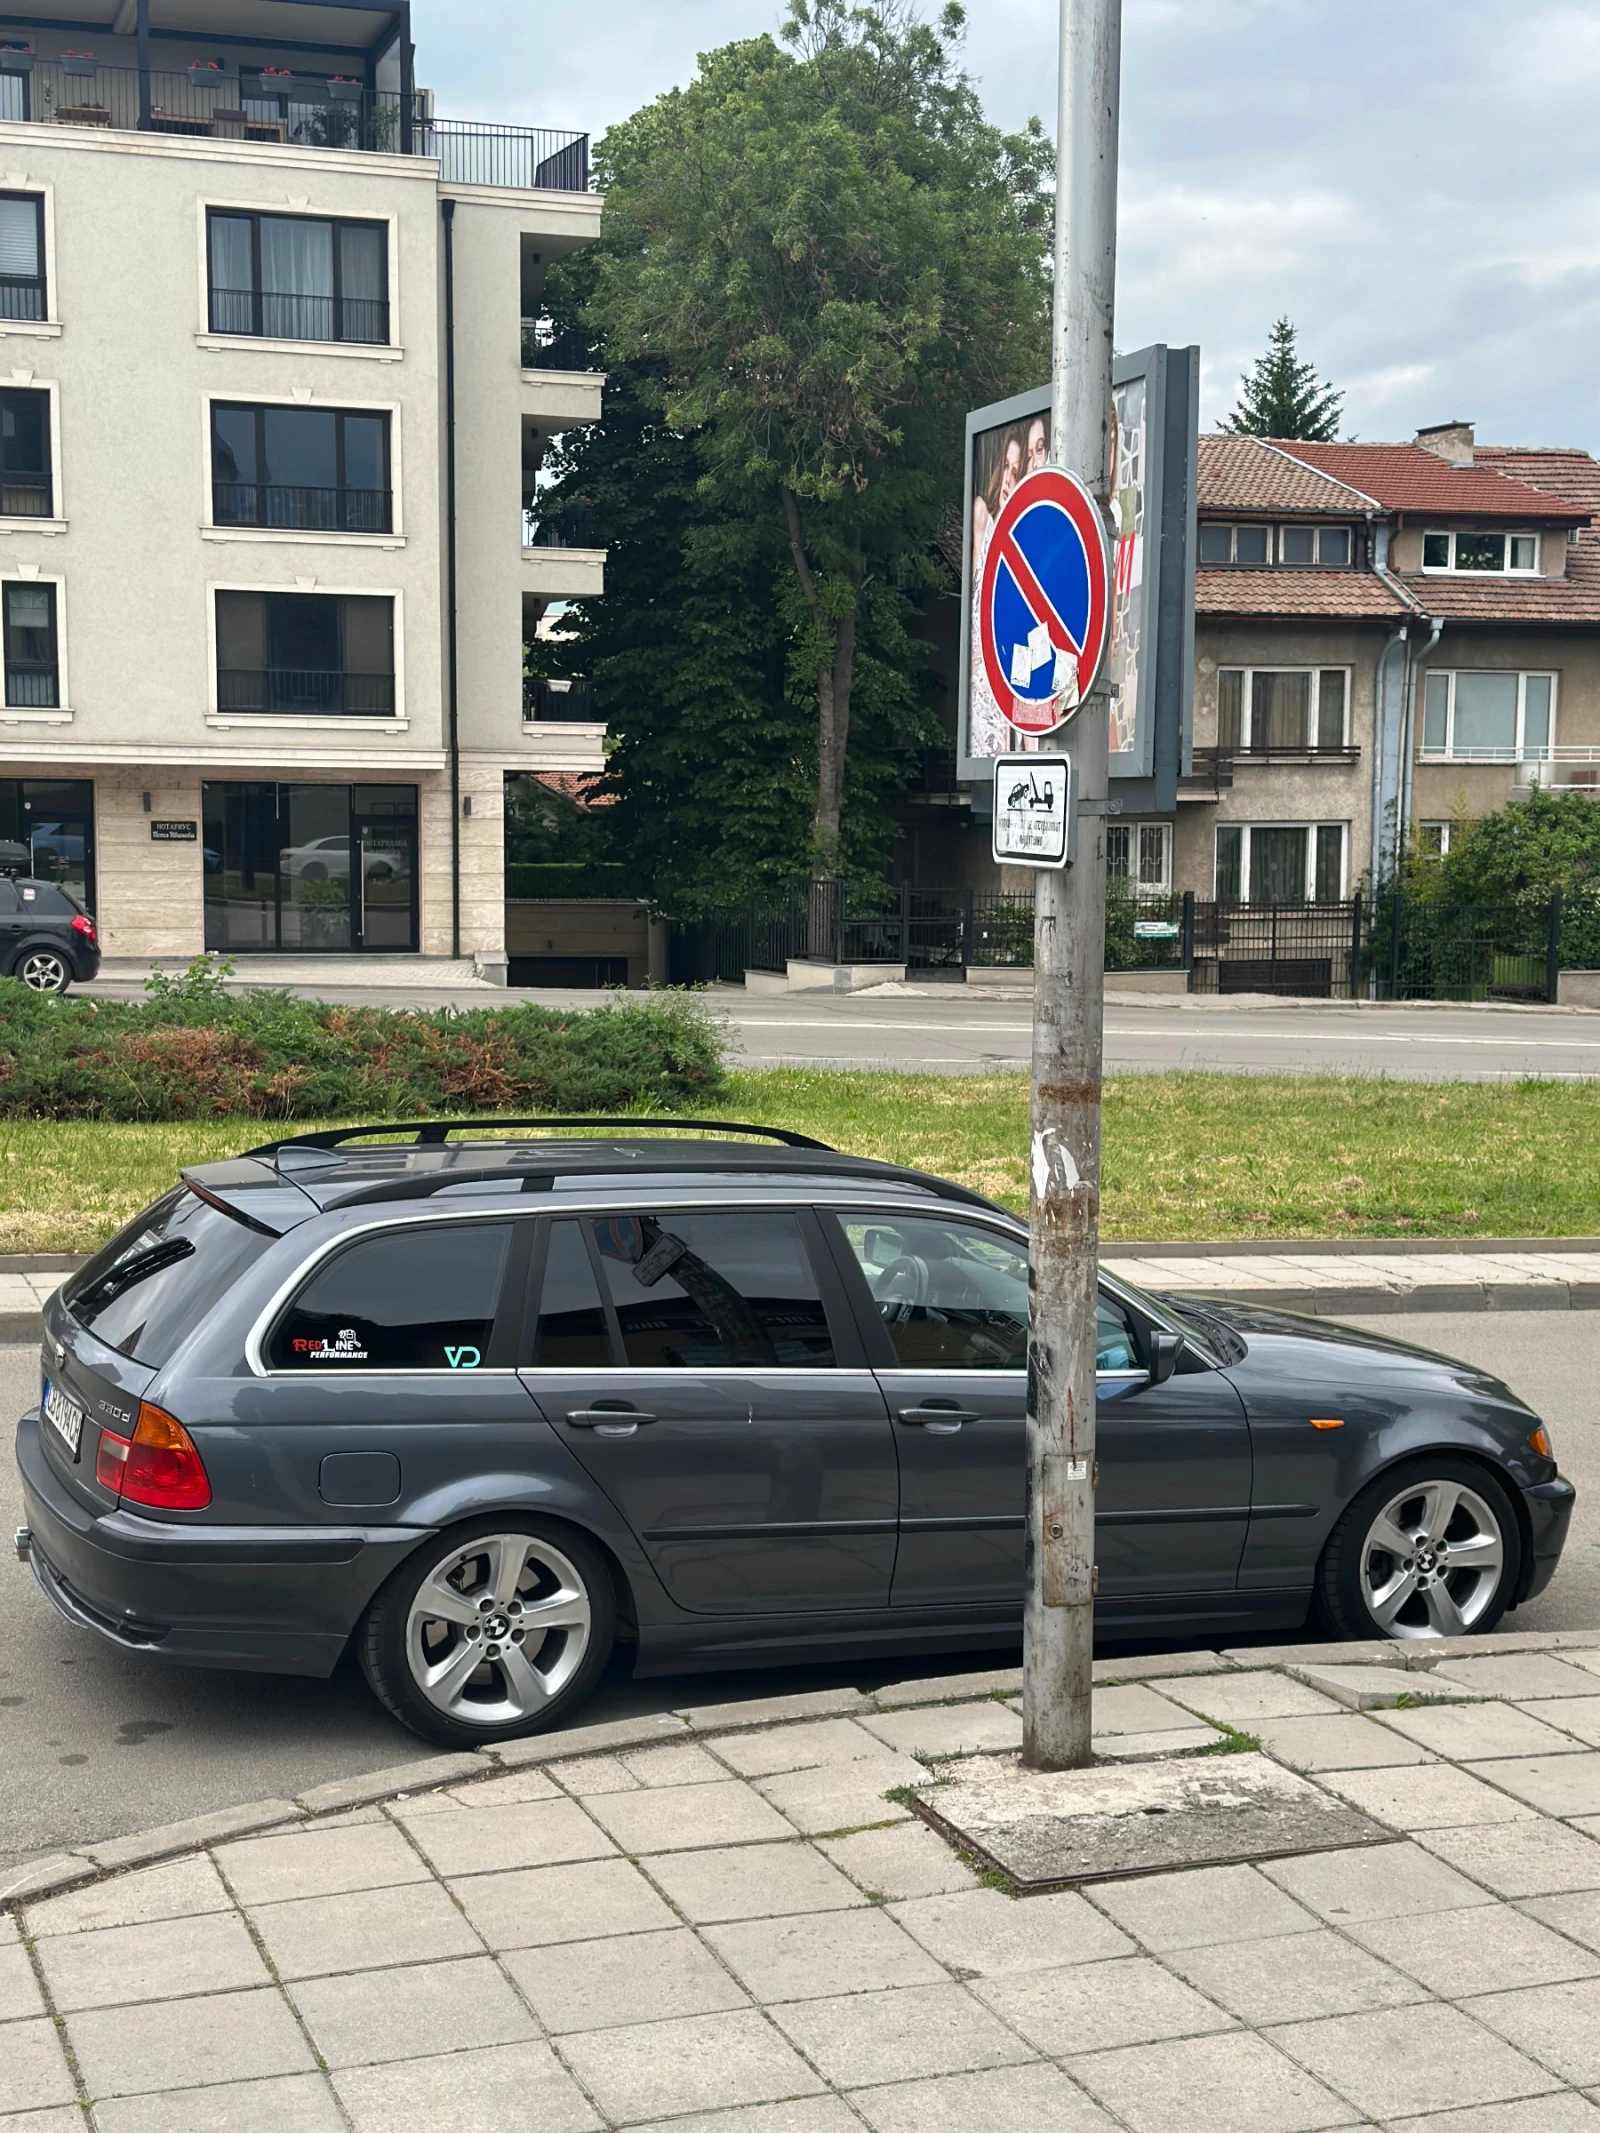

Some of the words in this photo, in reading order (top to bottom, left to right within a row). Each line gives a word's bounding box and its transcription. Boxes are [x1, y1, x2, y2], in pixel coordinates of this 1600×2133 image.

[310, 1351, 368, 1359] PERFORMANCE
[444, 1346, 480, 1368] VD
[99, 1399, 131, 1422] 330d
